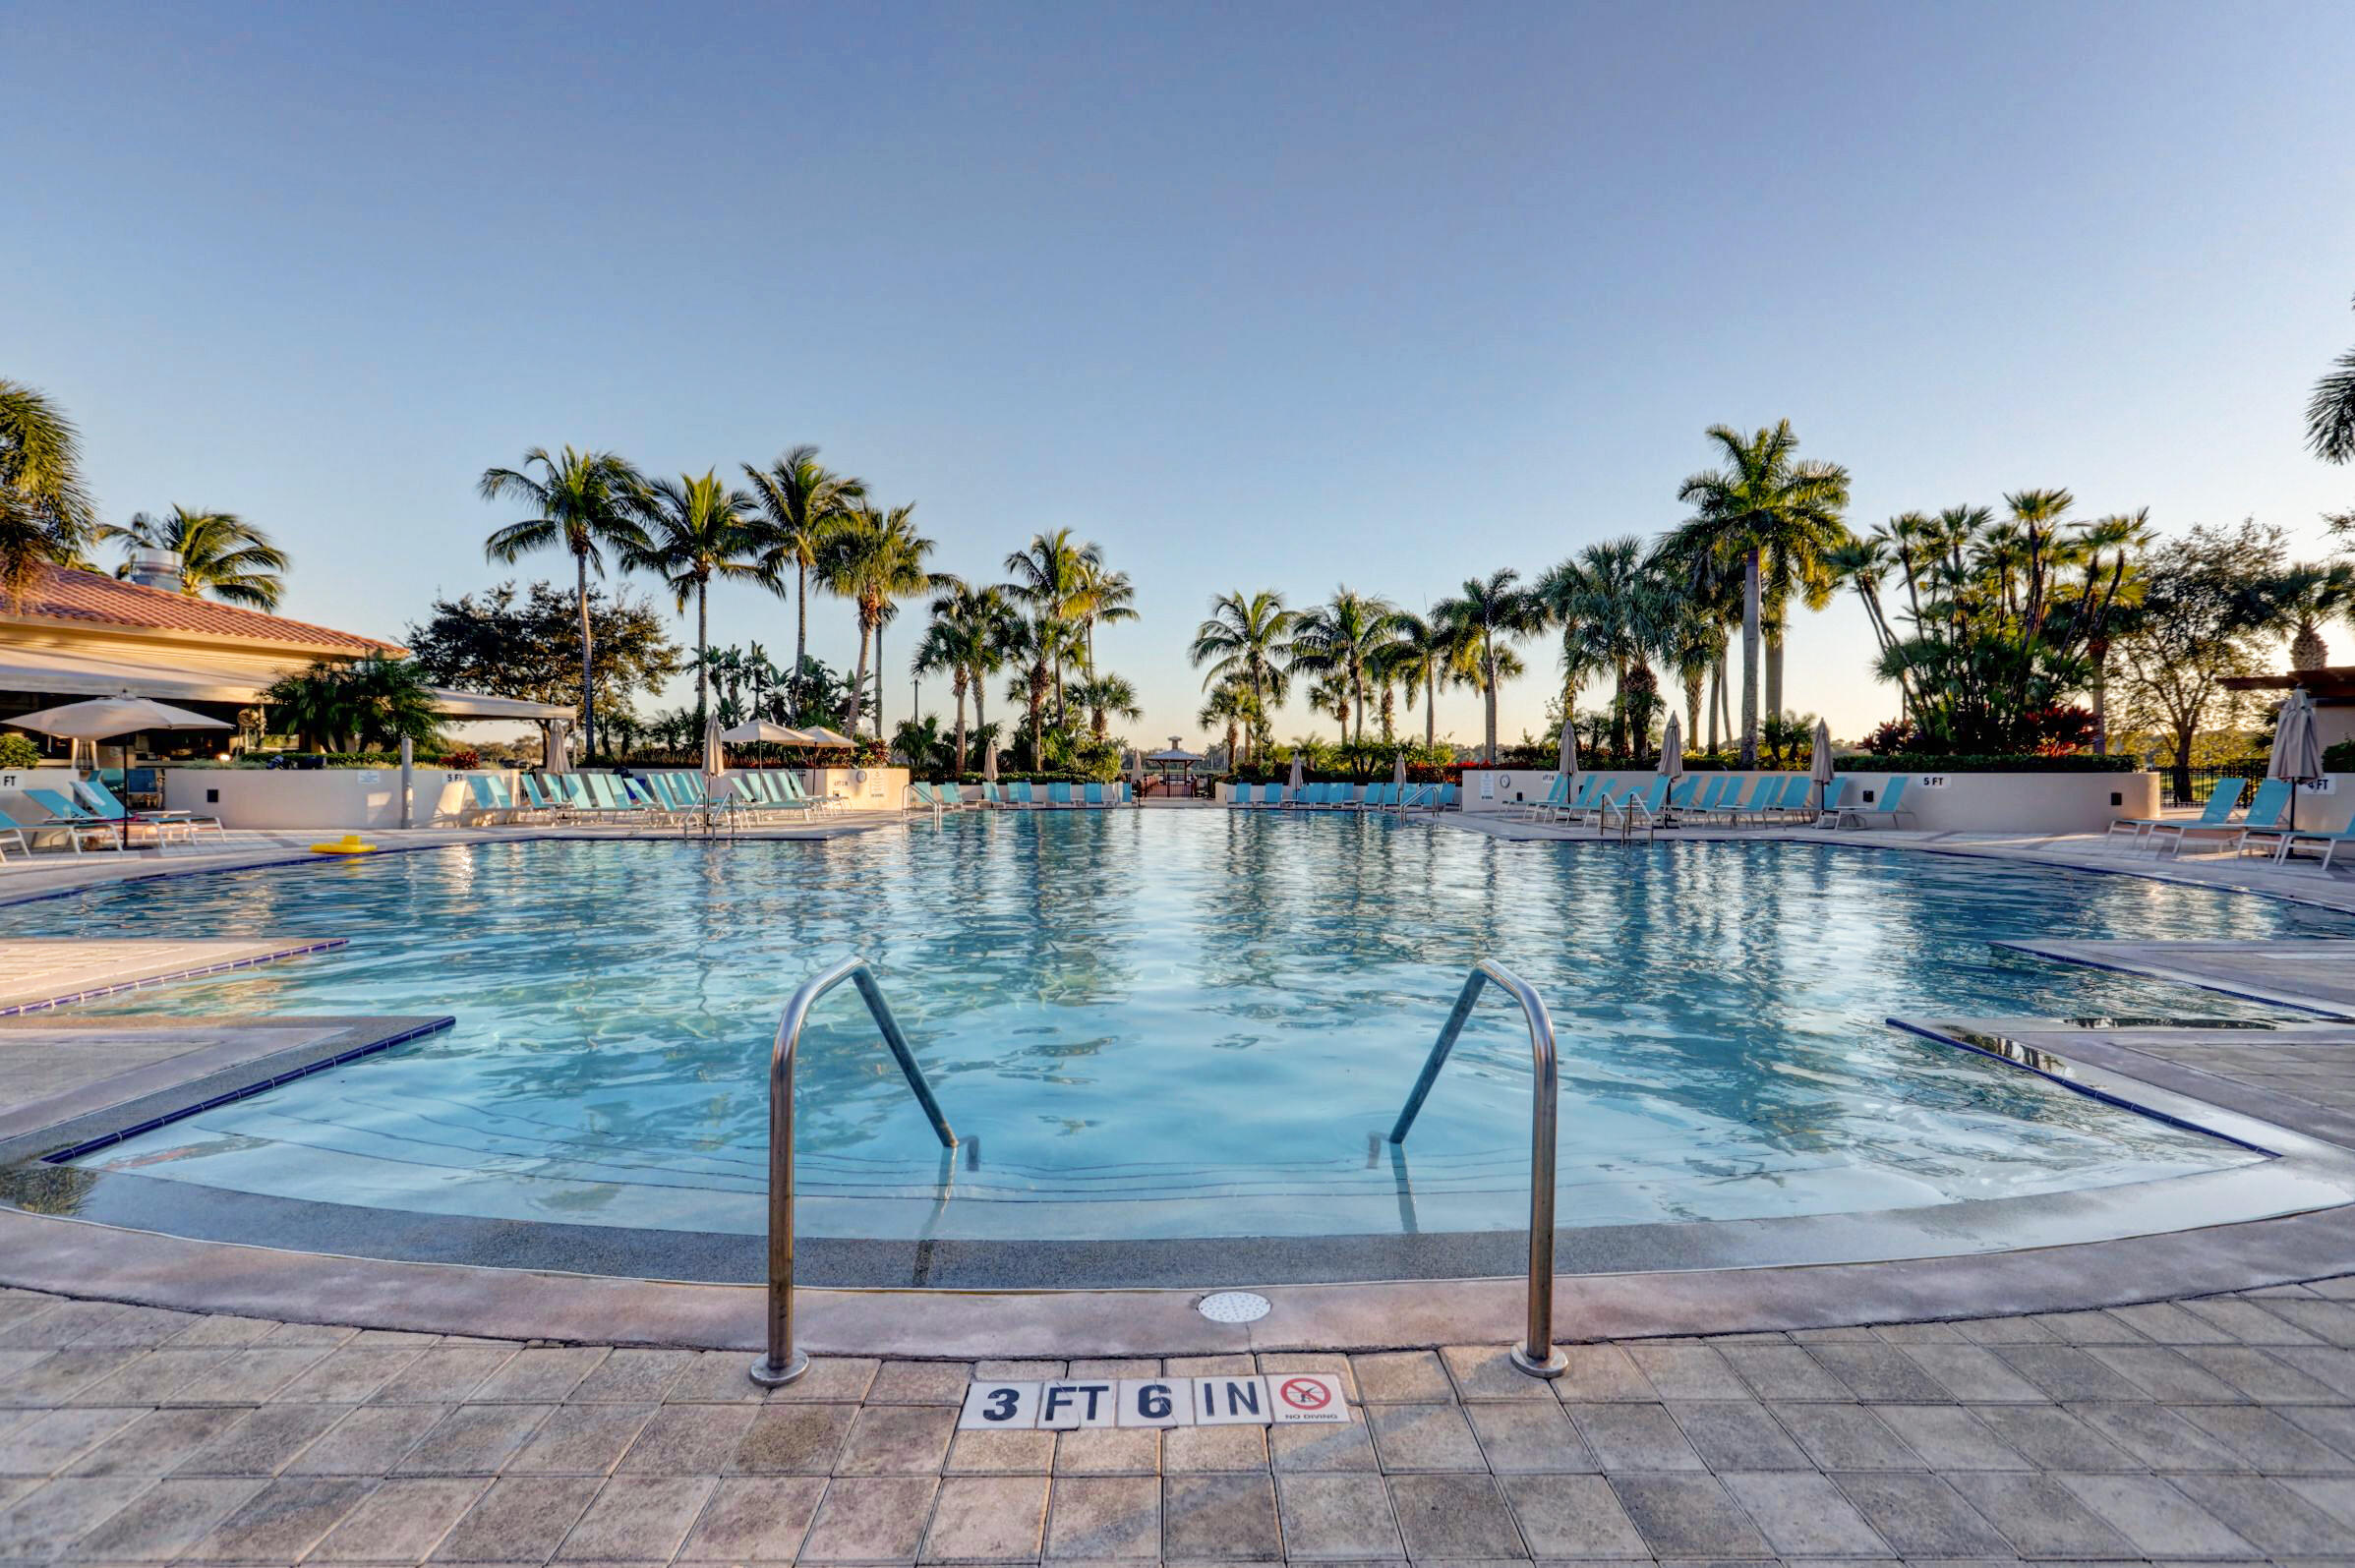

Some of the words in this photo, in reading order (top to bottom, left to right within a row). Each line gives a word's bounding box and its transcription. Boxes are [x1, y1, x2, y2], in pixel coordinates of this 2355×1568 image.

[4, 776, 16, 786] FT
[1923, 777, 1929, 785] 5
[1932, 777, 1943, 785] FT
[2317, 779, 2328, 790] FT
[982, 1388, 1020, 1422] 3
[1044, 1385, 1109, 1422] FT
[1138, 1384, 1172, 1419] 6
[1204, 1381, 1260, 1417] IN
